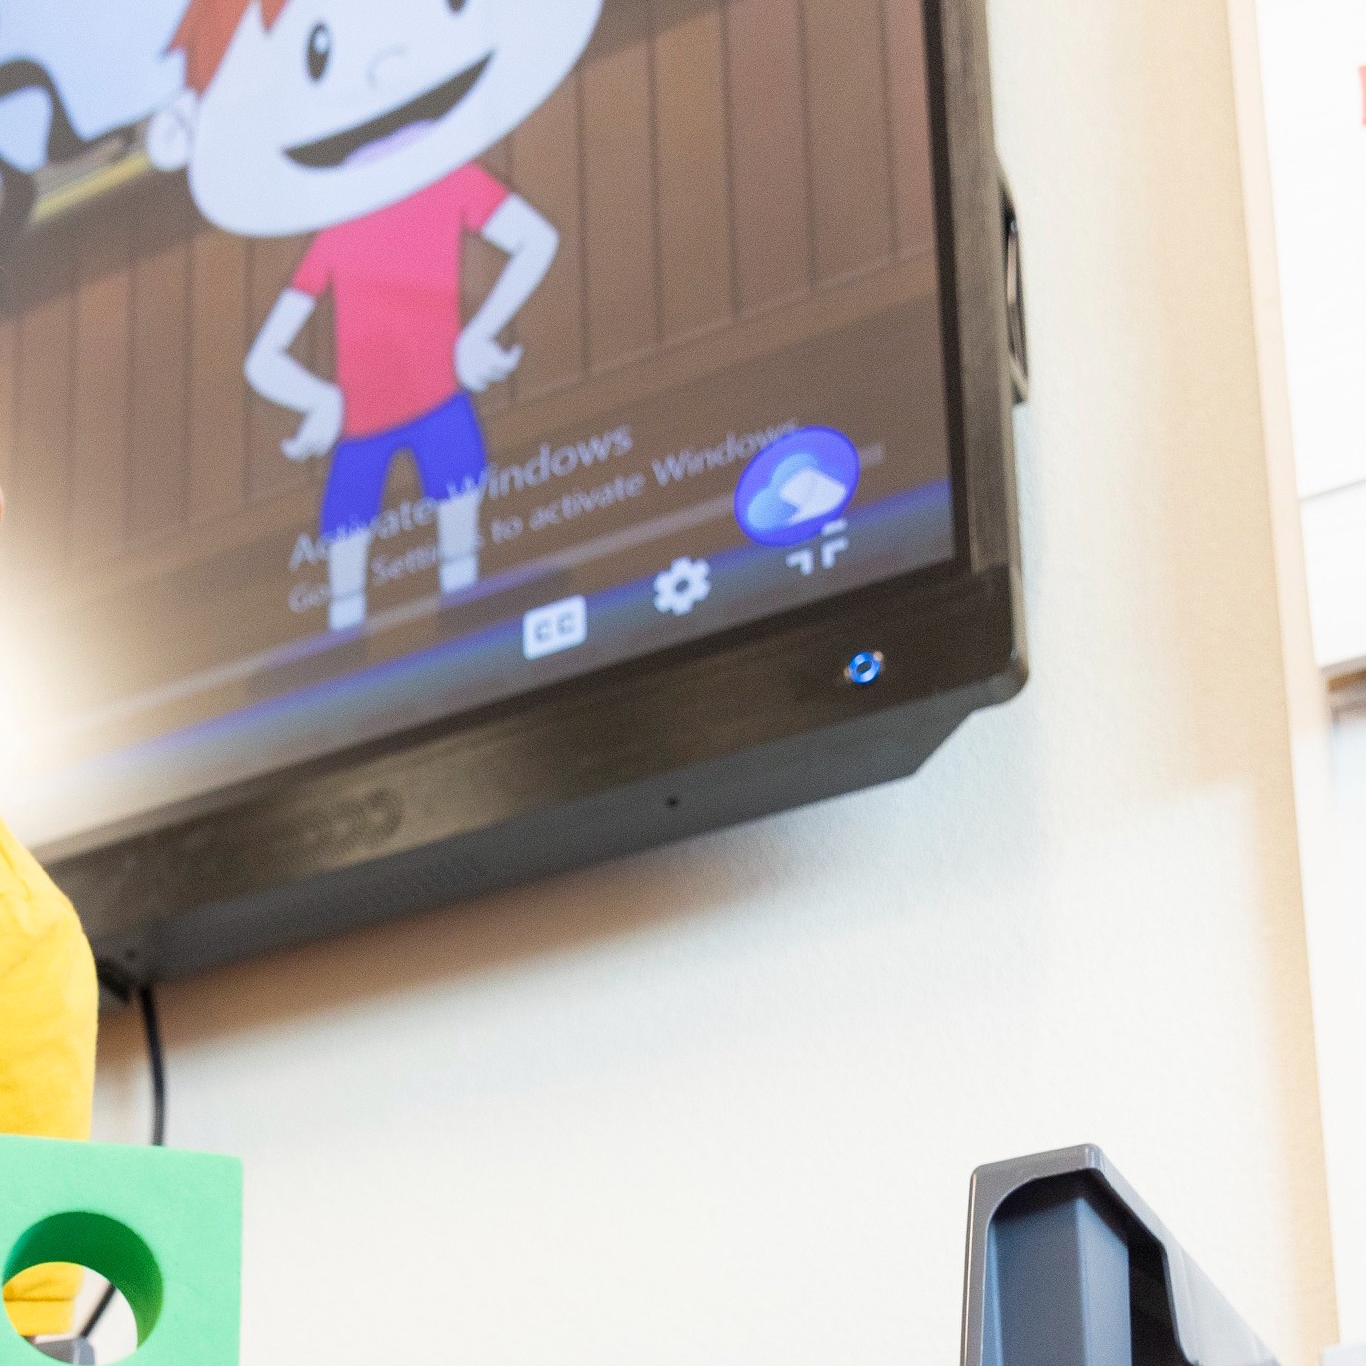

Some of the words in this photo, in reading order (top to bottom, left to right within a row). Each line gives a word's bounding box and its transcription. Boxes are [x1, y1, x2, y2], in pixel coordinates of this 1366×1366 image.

[445, 424, 634, 512] Windows
[491, 516, 524, 545] to
[528, 472, 646, 532] activate
